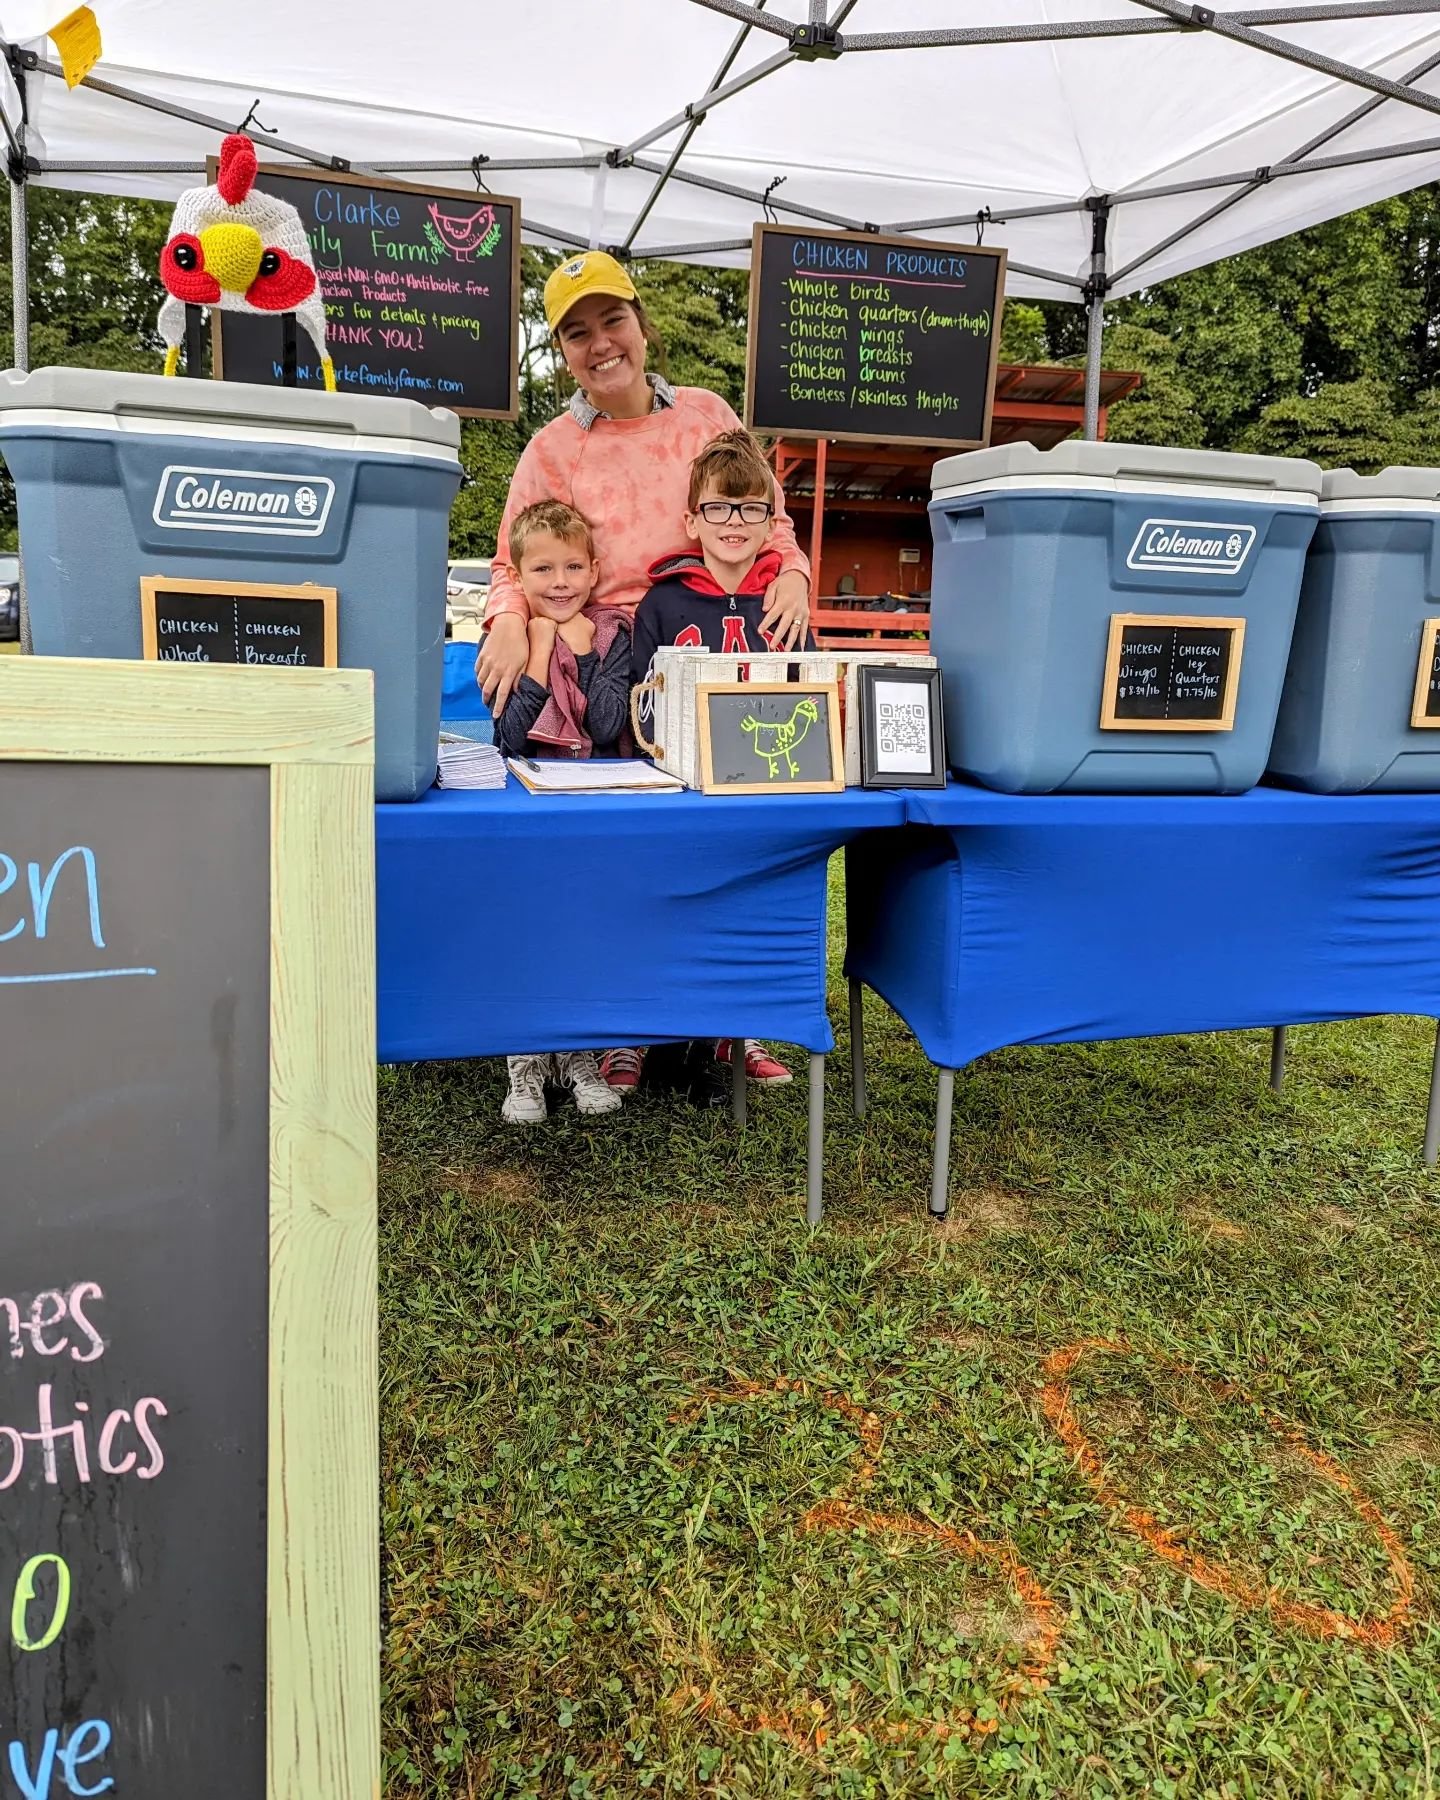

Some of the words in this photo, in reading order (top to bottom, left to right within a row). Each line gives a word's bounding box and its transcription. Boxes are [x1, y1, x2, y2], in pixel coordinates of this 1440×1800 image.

[315, 188, 400, 227] Clarke
[371, 230, 439, 265] Farms
[792, 240, 868, 270] CHICKEN
[886, 251, 968, 278] PRODUCTS
[362, 284, 407, 302] Products
[850, 282, 891, 302] birds
[353, 301, 373, 319] for
[380, 305, 427, 326] details
[440, 314, 481, 341] pricing
[858, 304, 918, 327] quarters
[324, 320, 373, 346] HANK
[860, 328, 905, 351] wings
[859, 346, 913, 366] breasts
[860, 366, 907, 384] drums
[916, 388, 959, 416] thighs
[175, 476, 290, 514] Coleman
[1145, 527, 1224, 557] Coleman
[159, 618, 219, 634] CHICKEN
[245, 623, 301, 636] CHICKEN
[245, 645, 308, 665] Breasts
[1121, 643, 1163, 656] CHICKEN
[1179, 645, 1221, 657] CHICKEN
[1175, 671, 1220, 686] Quarters
